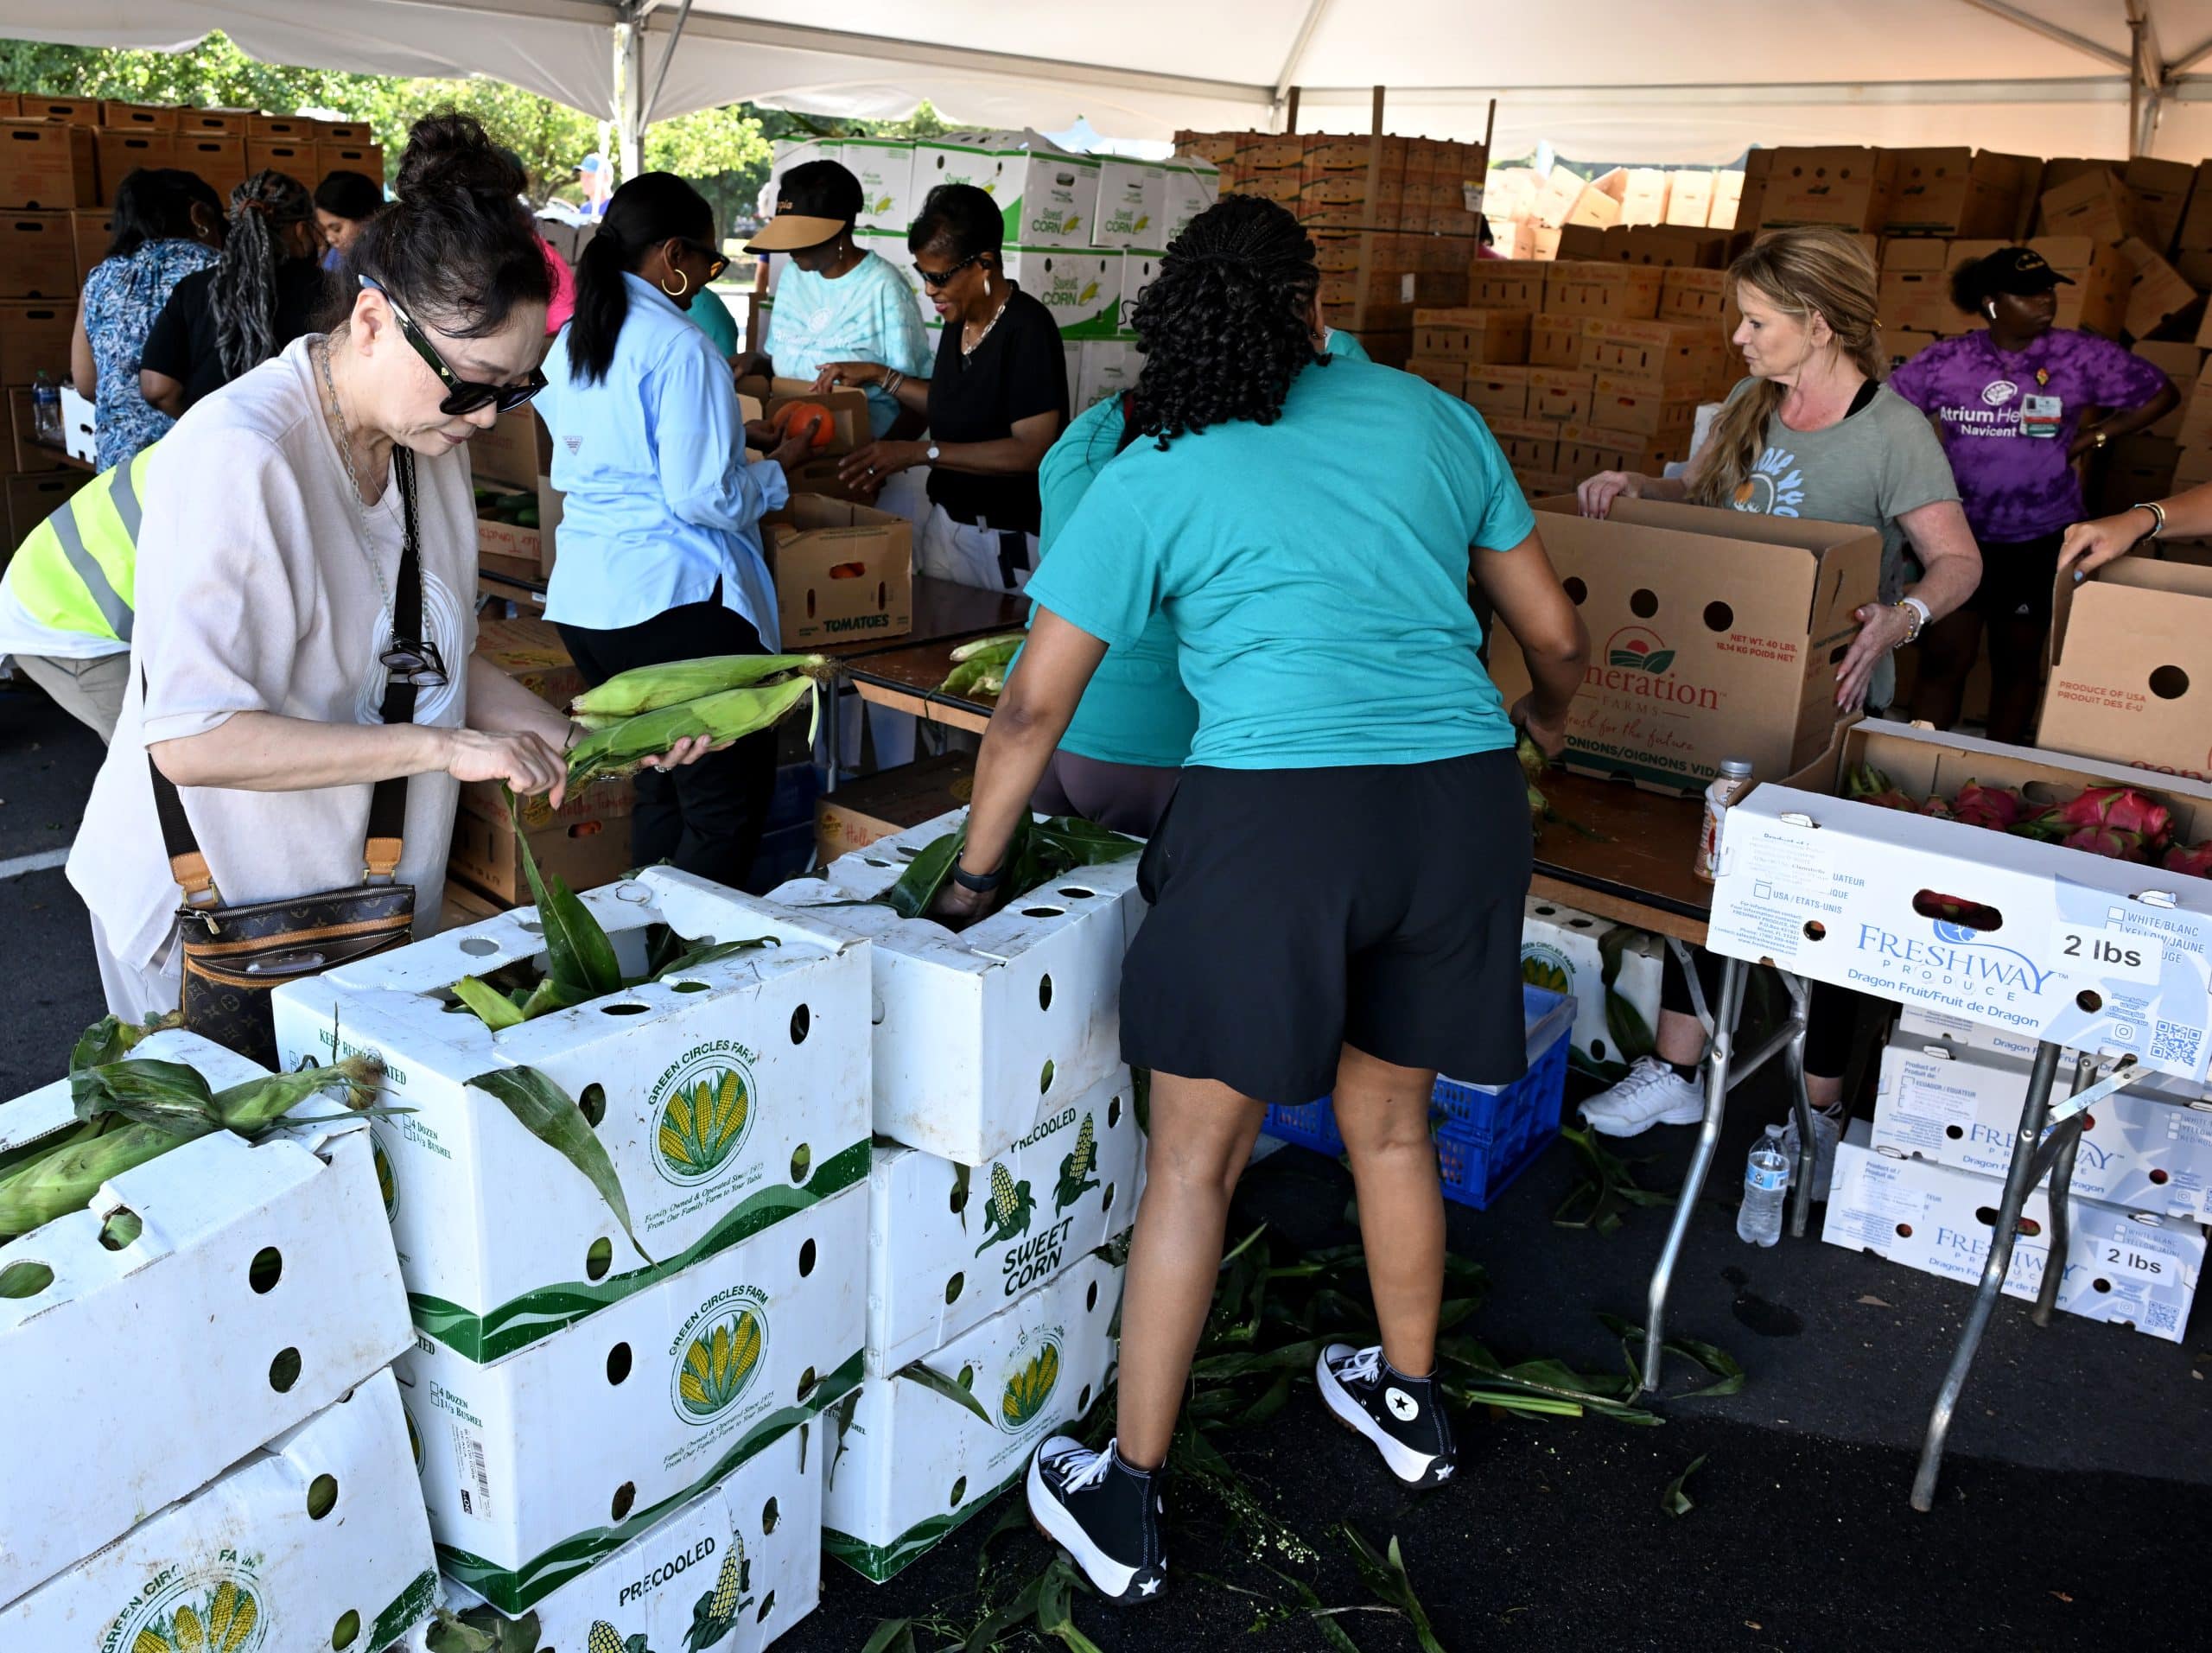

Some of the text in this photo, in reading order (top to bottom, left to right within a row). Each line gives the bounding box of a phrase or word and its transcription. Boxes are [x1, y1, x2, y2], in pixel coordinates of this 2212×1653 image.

[1032, 219, 1061, 233] CORN
[1105, 220, 1133, 233] CORN
[1042, 291, 1077, 305] CORN
[1940, 406, 1994, 423] Atrium
[1961, 424, 2017, 437] Navicent
[823, 614, 889, 633] TOMATOES
[1730, 633, 1747, 643] NET
[1749, 637, 1764, 646] WT.
[1716, 642, 1735, 652] 18.14
[1750, 648, 1776, 659] POIDS
[1777, 653, 1796, 663] NET
[1583, 664, 1719, 711] neration
[2059, 681, 2147, 703] PRODUCE OF USA
[1602, 696, 1659, 717] FARMS
[2057, 690, 2144, 712] PRODUIT DES E-U
[1567, 735, 1688, 772] ONIONS/OIGNONS
[1832, 872, 1866, 887] UATEUR
[1773, 891, 1789, 901] USA
[1796, 893, 1843, 914] ETATS-UNIS
[2127, 912, 2199, 938] WHITE/BLANC
[1856, 923, 2058, 995] FRESHWAY
[2063, 934, 2082, 957] 2
[2094, 939, 2141, 967] lbs
[1883, 959, 2016, 1001] PRODUCE
[1847, 968, 1895, 989] Dragon
[1898, 981, 1963, 1008] Fruit/Fruit
[1967, 1001, 1985, 1014] de
[1987, 1005, 2039, 1028] Dragon
[1993, 1037, 2030, 1053] Dragon
[648, 1061, 681, 1106] GREEN
[681, 1039, 730, 1065] CIRCLES
[1904, 1060, 1929, 1071] Product
[1916, 1080, 1942, 1091] ECUADOR
[1946, 1086, 1976, 1098] EQUATEUR
[411, 1119, 416, 1128] 4
[1962, 1154, 1999, 1170] Dragon
[646, 1220, 664, 1233] From
[667, 1212, 680, 1224] Our
[681, 1199, 704, 1217] Family
[705, 1192, 722, 1205] Farm
[731, 1180, 746, 1192] Your
[747, 1172, 762, 1184] Table
[671, 1196, 693, 1211] Owned
[694, 1192, 701, 1201] &
[702, 1177, 731, 1198] Operated
[1002, 1216, 1074, 1275] SWEET
[1005, 1247, 1063, 1297] CORN
[2107, 1248, 2161, 1274] 2 lbs
[1929, 1257, 1965, 1274] Dragon
[2016, 1282, 2029, 1292] de
[669, 1285, 769, 1357] GREEN CIRCLES FARM
[439, 1386, 468, 1409] 4 DOZEN
[456, 1405, 483, 1428] BUSHEL
[664, 1458, 682, 1472] From
[683, 1449, 696, 1460] Our
[696, 1436, 718, 1453] Family
[718, 1426, 735, 1439] Farm
[619, 1536, 715, 1607] PRECOOLED
